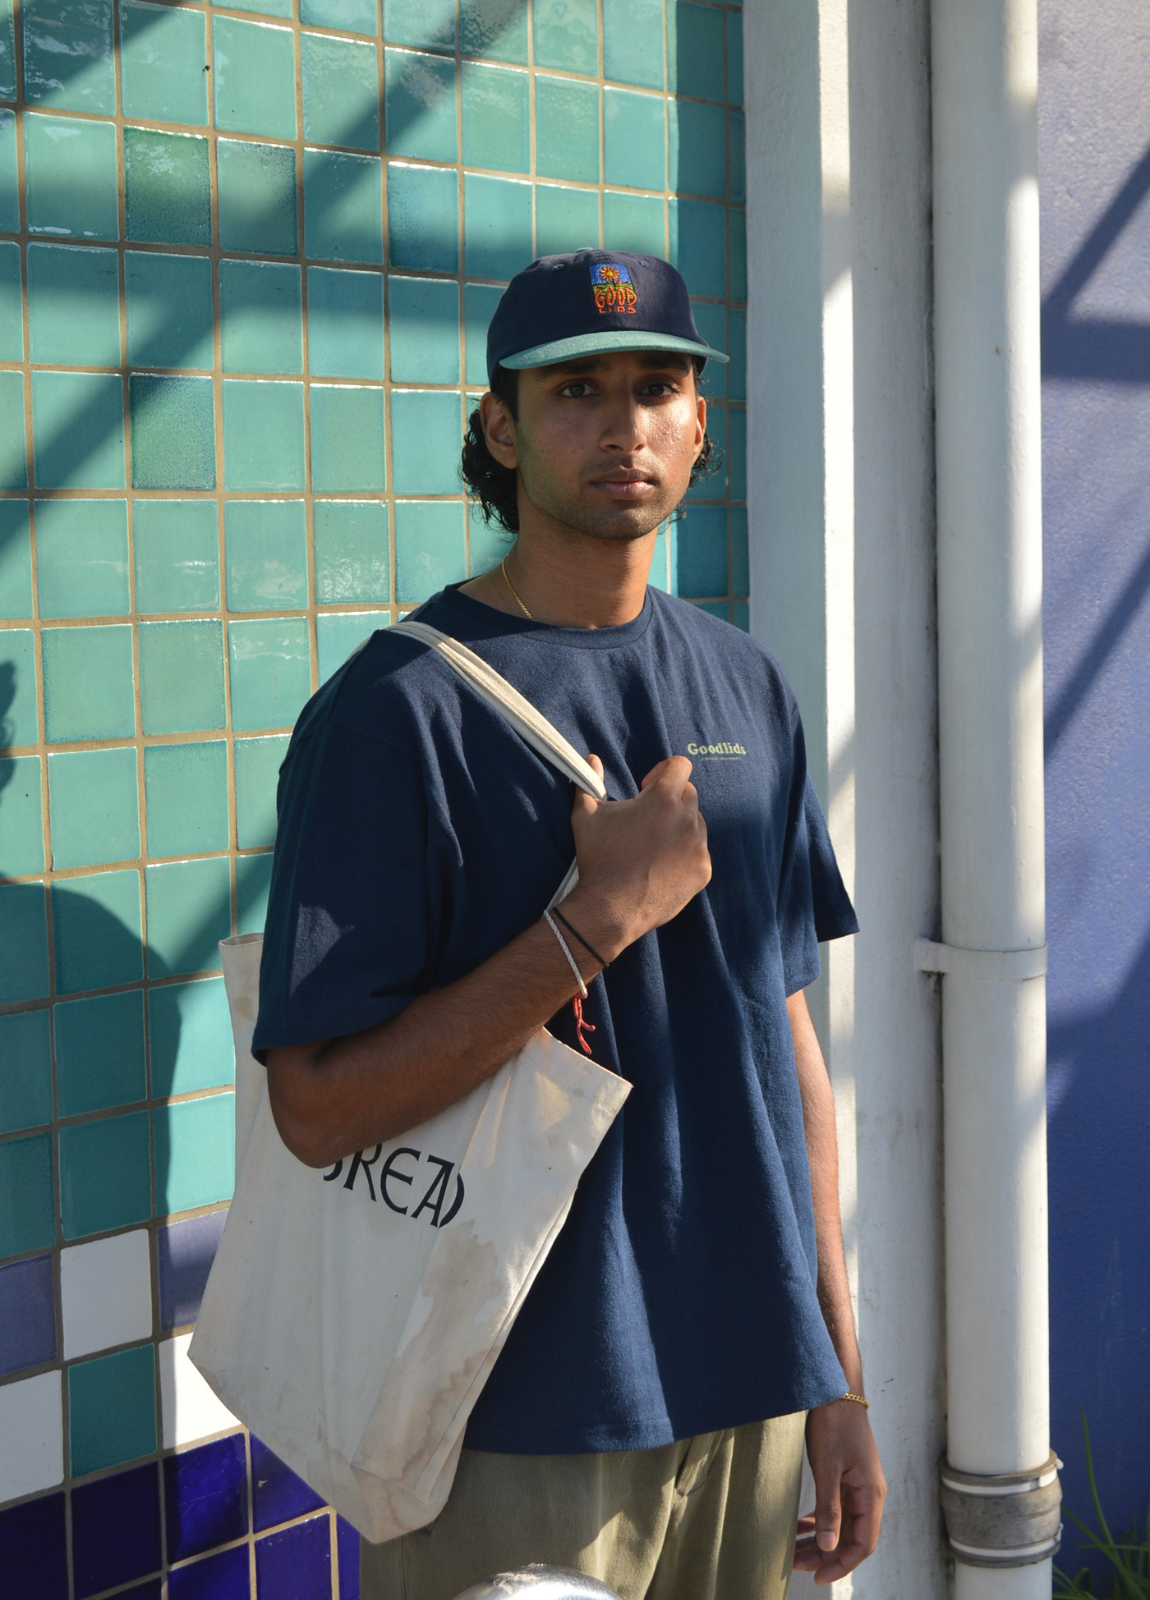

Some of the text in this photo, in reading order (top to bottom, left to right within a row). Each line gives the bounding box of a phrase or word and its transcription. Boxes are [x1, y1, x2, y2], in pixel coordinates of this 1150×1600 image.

[594, 286, 637, 308] GOOD
[598, 305, 636, 314] LIDS
[687, 742, 746, 755] Goodlids
